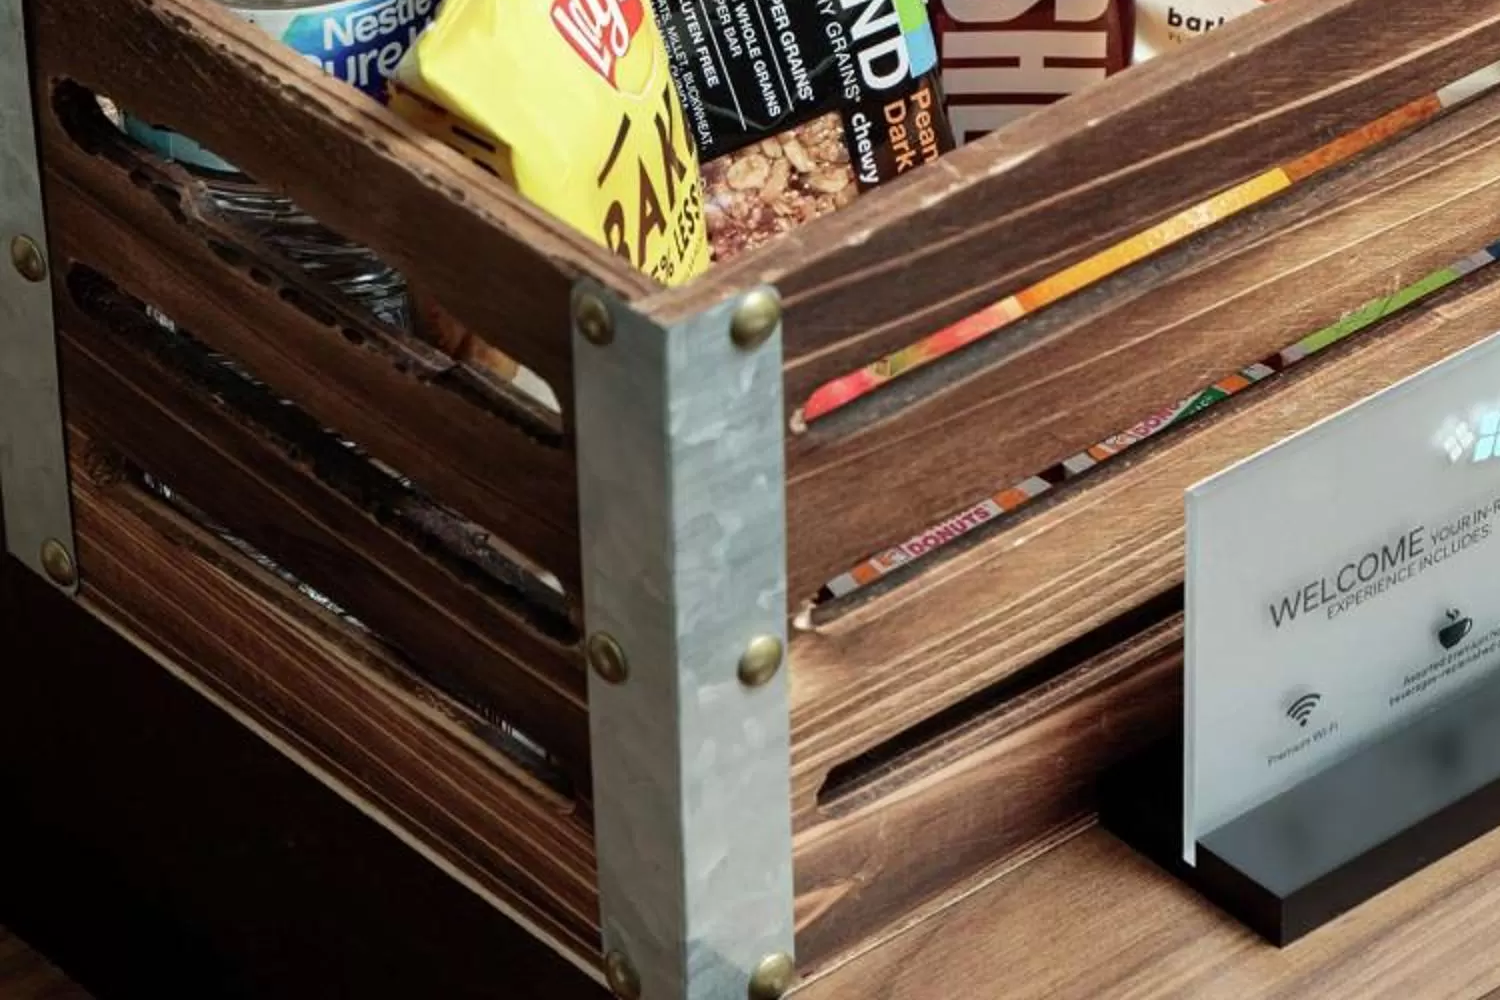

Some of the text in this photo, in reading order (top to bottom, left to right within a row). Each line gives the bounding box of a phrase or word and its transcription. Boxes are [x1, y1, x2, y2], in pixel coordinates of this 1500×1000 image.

[699, 43, 720, 89] FREE
[723, 27, 743, 58] BAR
[734, 2, 762, 59] WHOLE
[753, 58, 782, 118] GRAINS
[852, 111, 880, 185] chewy
[884, 99, 914, 172] Dark
[902, 506, 992, 556] DONUTS
[1268, 525, 1425, 629] WELCOME
[1429, 513, 1471, 545] YOUR
[1326, 561, 1418, 621] EXPERIENCE
